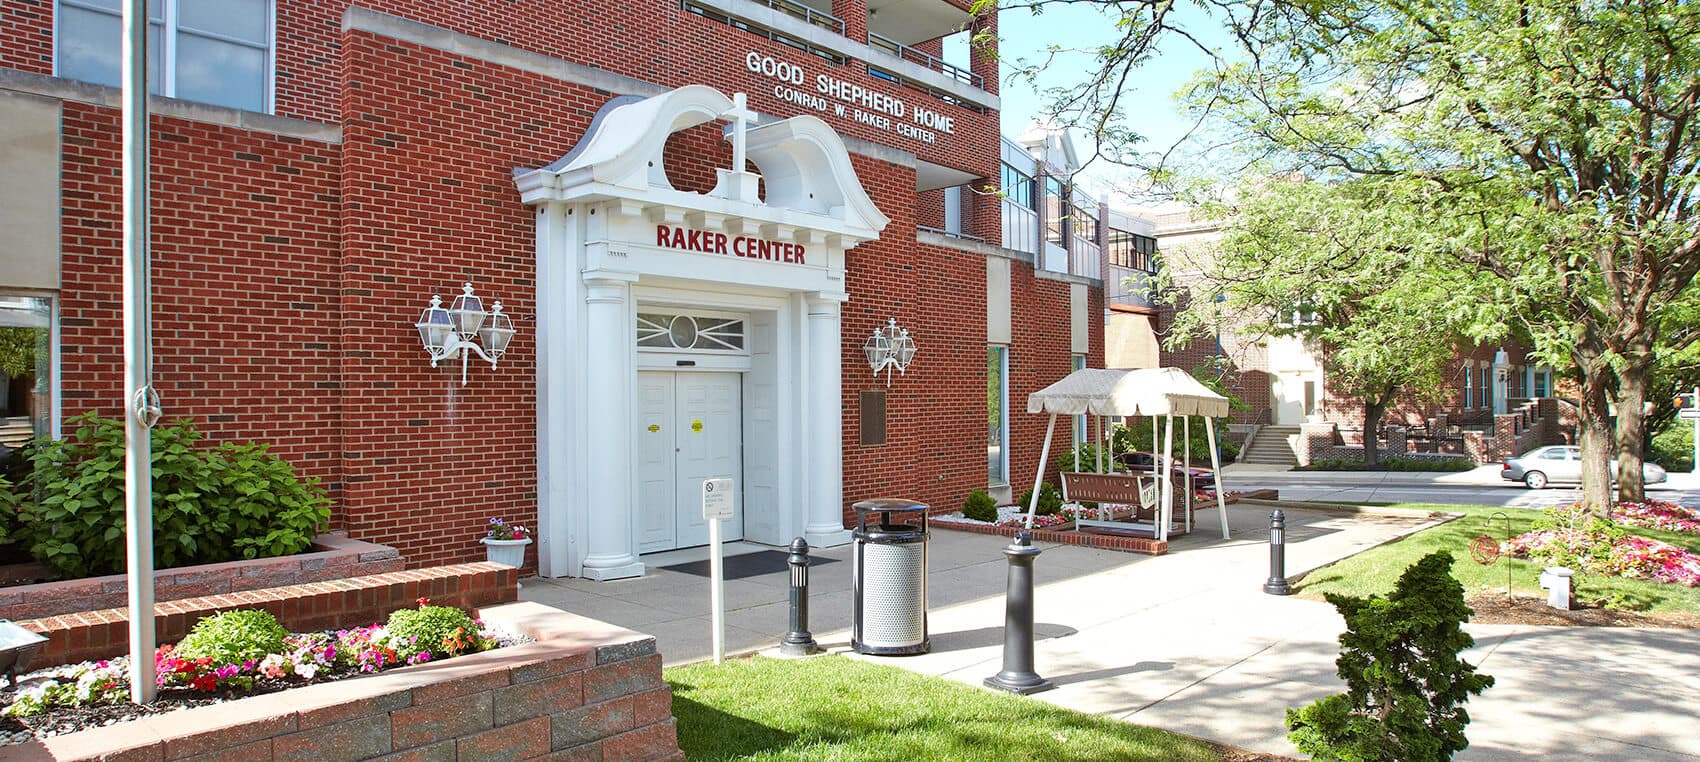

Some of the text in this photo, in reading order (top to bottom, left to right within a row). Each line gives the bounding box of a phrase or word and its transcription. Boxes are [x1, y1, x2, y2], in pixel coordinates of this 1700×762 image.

[746, 51, 954, 134] GOOD SHEPHERD HOME
[774, 85, 935, 144] CONRAD W. RAKER CENTER
[656, 225, 806, 265] RAKER CENTER
